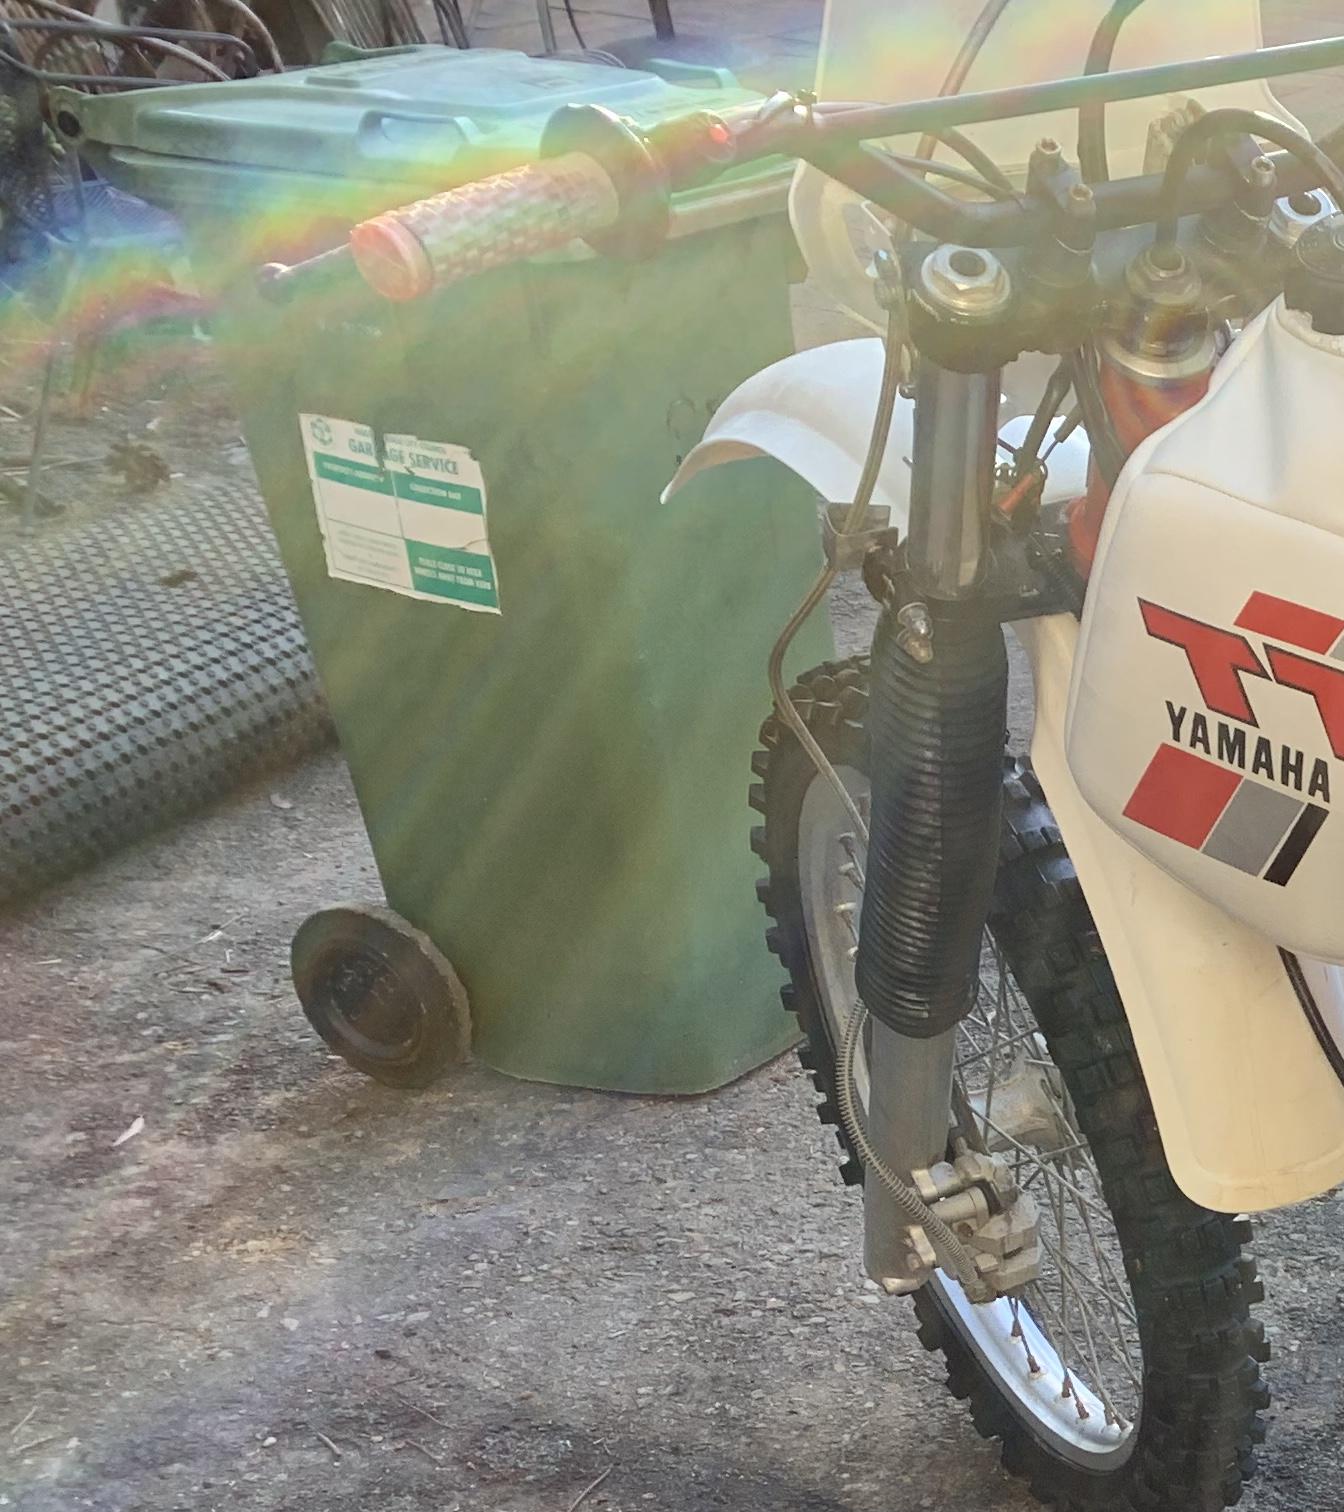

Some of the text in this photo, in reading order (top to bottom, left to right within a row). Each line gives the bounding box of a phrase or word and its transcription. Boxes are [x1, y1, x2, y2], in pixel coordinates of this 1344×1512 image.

[348, 438, 404, 463] GARAGE
[408, 451, 459, 476] SERVICE
[1165, 700, 1331, 804] YAMAHA
